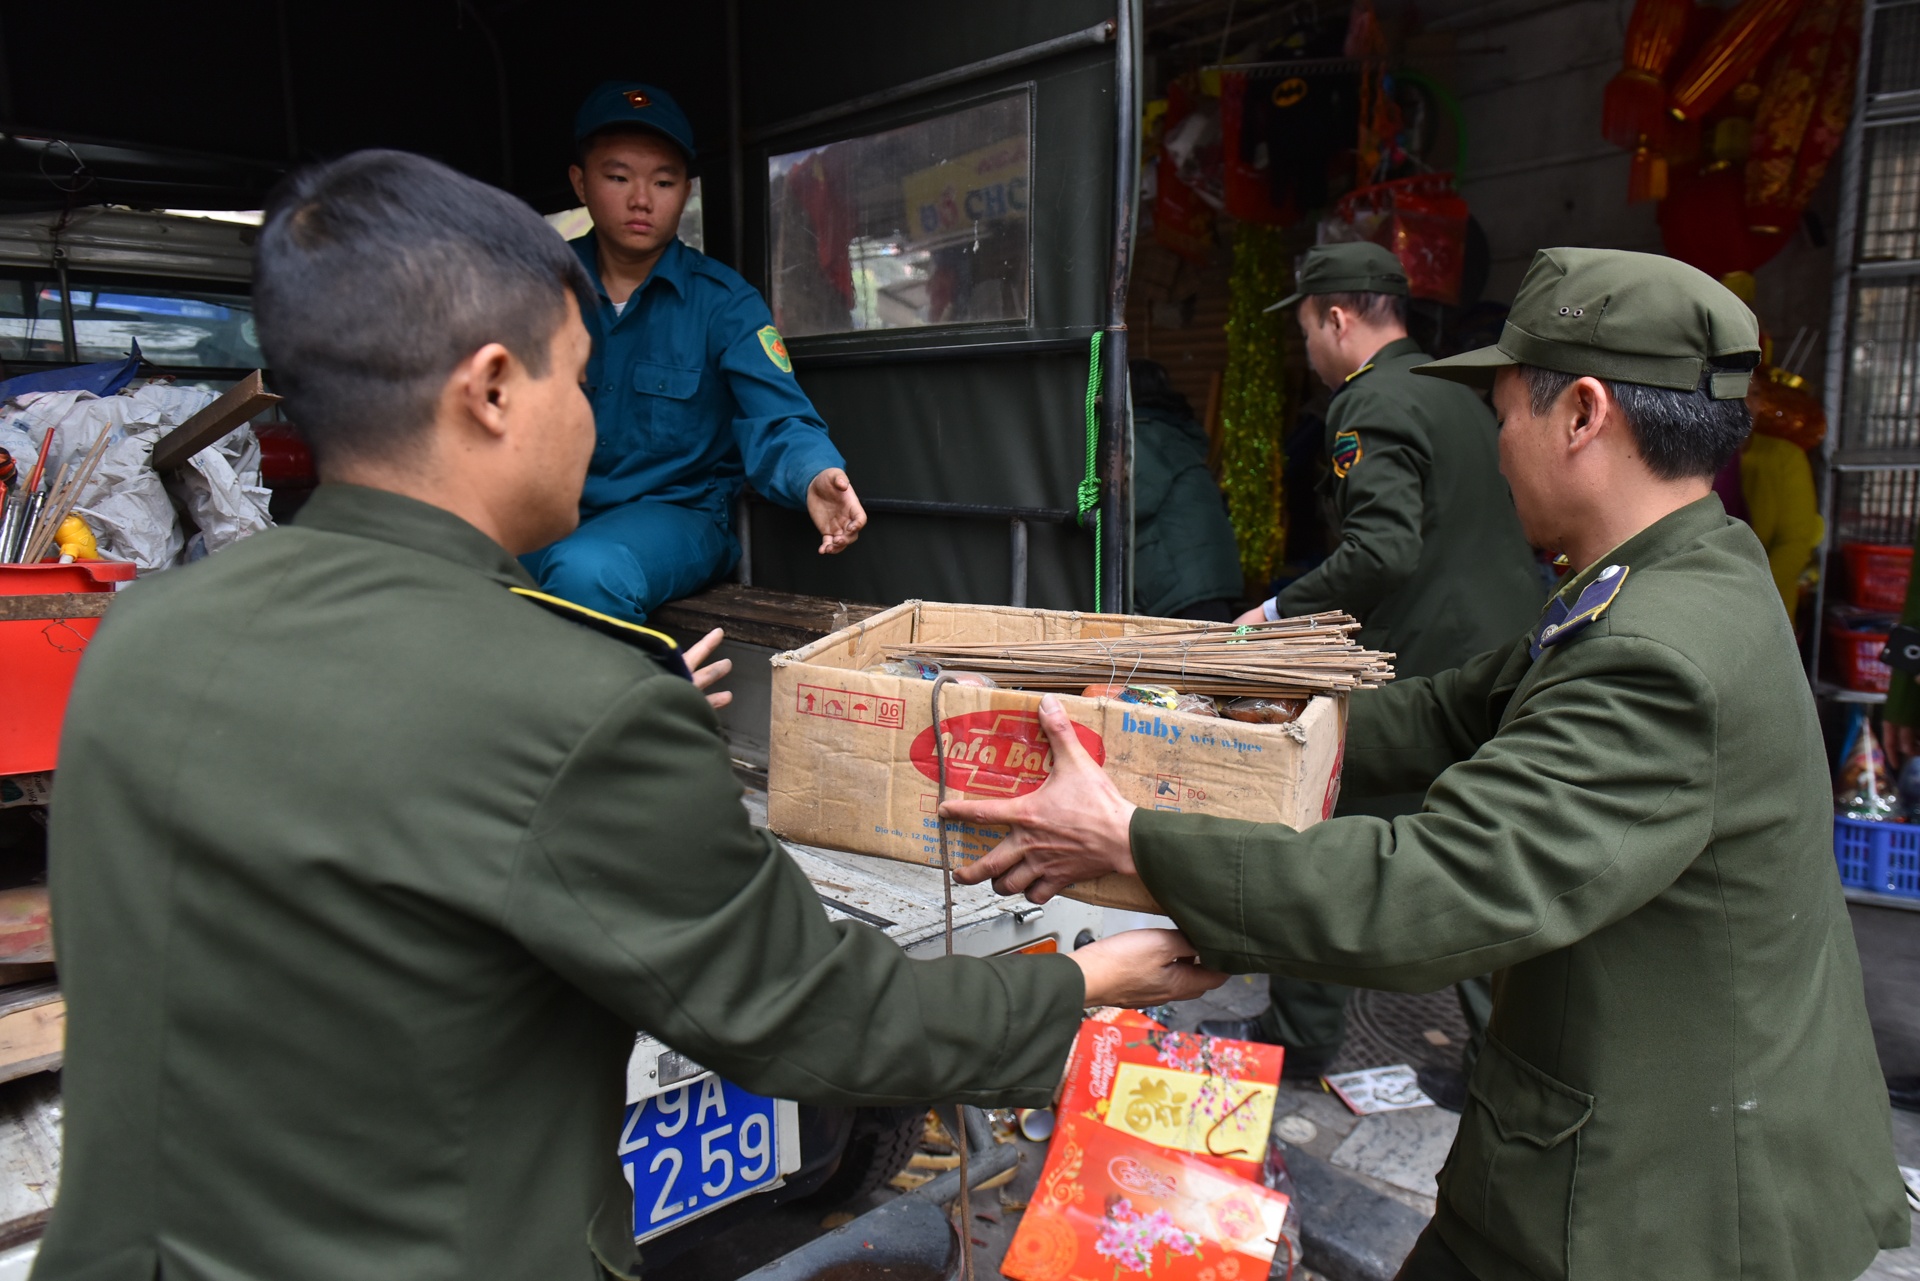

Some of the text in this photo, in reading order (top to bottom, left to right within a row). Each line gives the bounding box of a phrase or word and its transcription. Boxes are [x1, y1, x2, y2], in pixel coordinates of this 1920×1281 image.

[880, 702, 899, 717] 06
[932, 731, 998, 765] Anfa
[1123, 711, 1262, 753] baby wet wipes
[911, 832, 920, 840] 12
[617, 1072, 727, 1157] 29A
